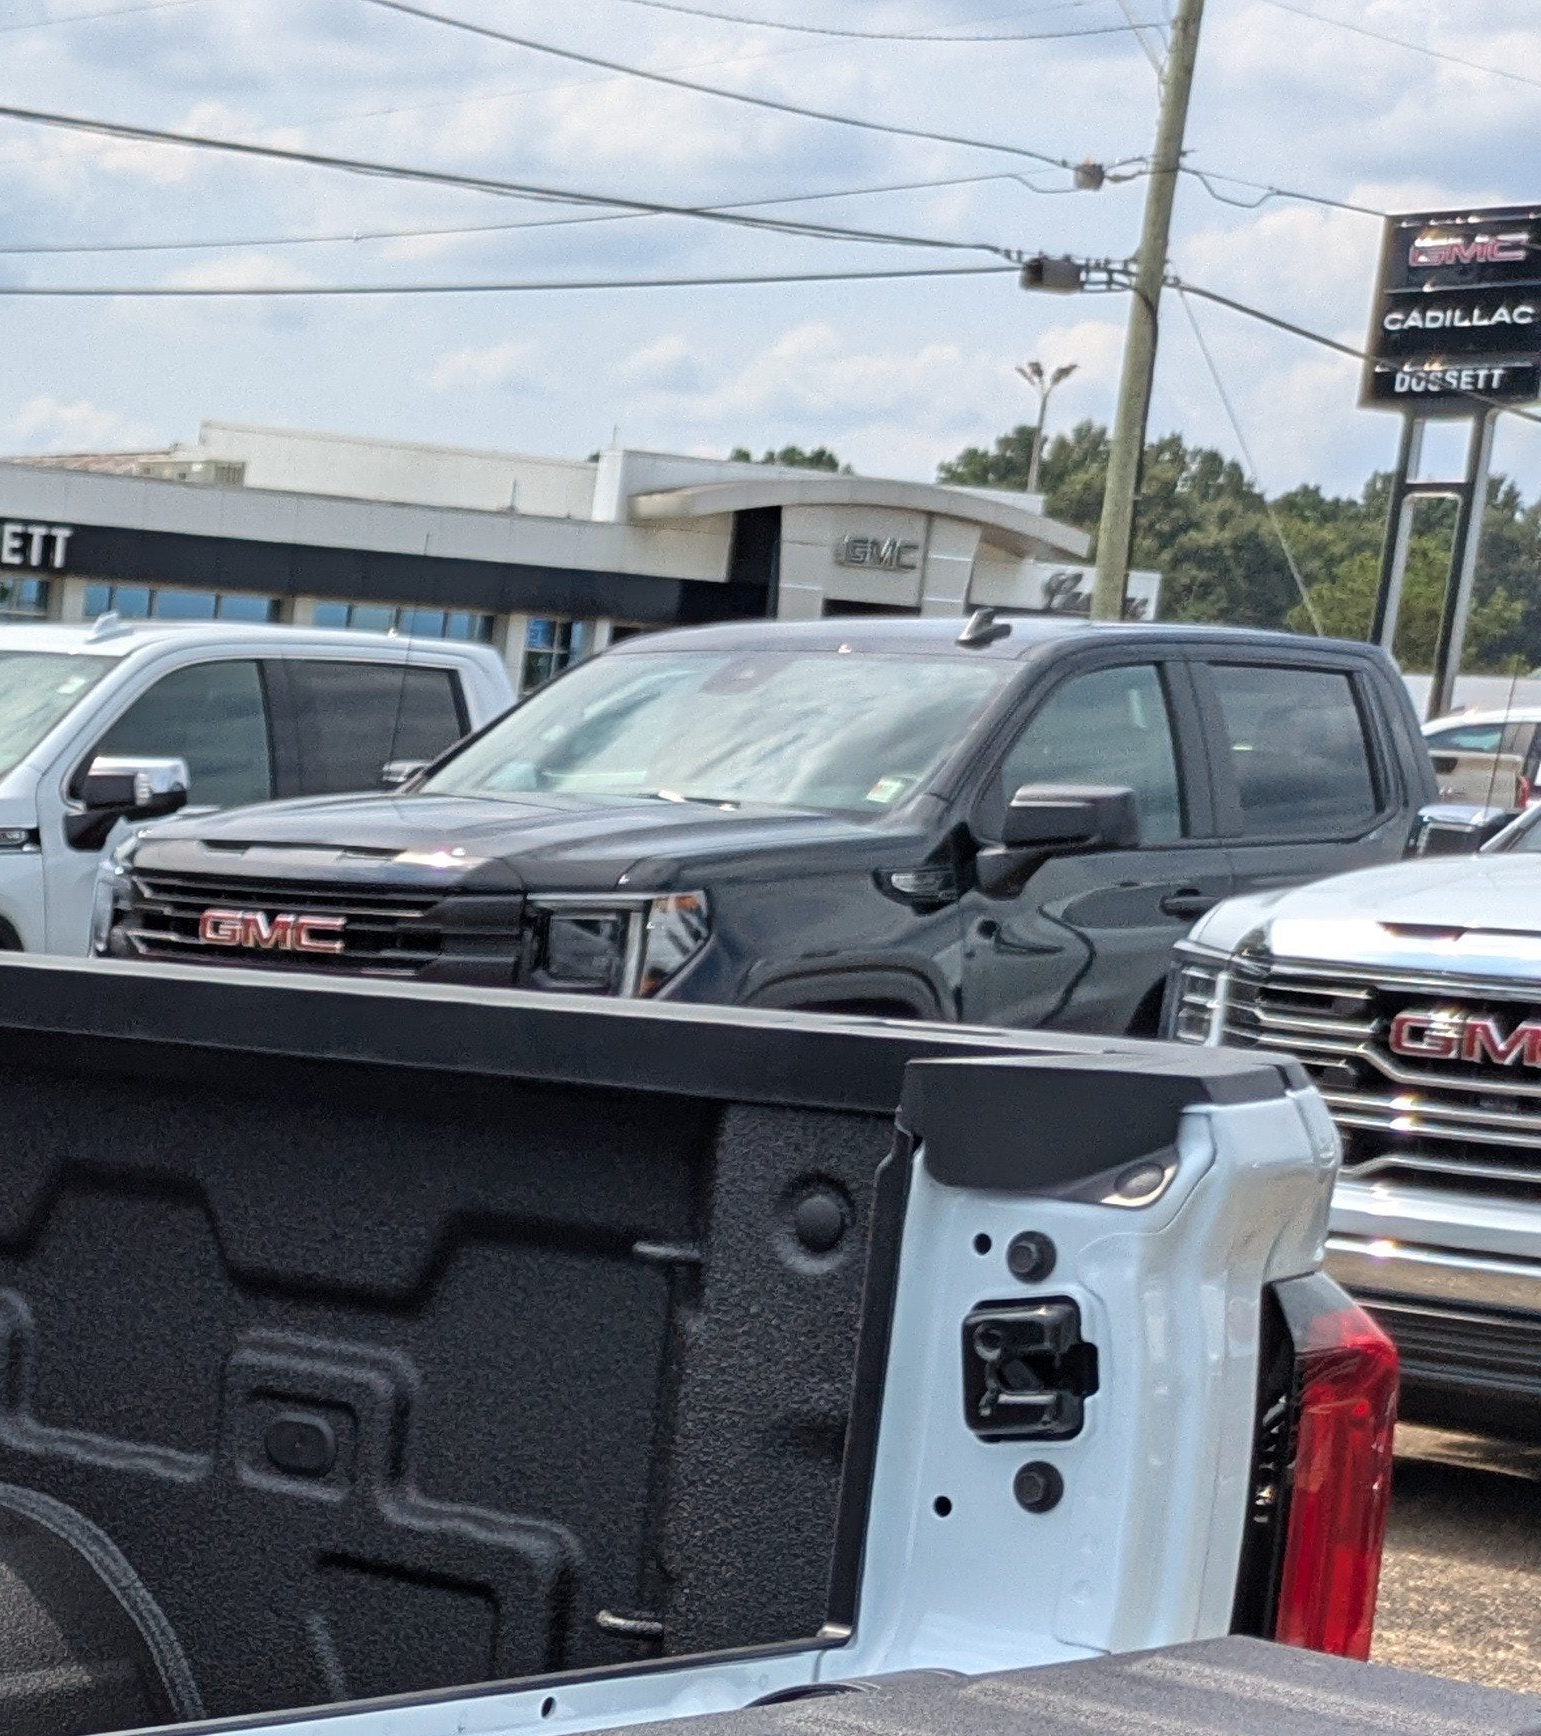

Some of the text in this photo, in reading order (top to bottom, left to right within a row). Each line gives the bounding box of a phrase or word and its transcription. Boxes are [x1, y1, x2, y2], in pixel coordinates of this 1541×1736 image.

[1409, 233, 1529, 267] GMC
[1383, 305, 1535, 331] CADILLAC
[1394, 368, 1505, 393] DOSSETT
[835, 535, 919, 570] GMC
[199, 907, 347, 954] GMC
[1388, 1010, 1541, 1068] GM
